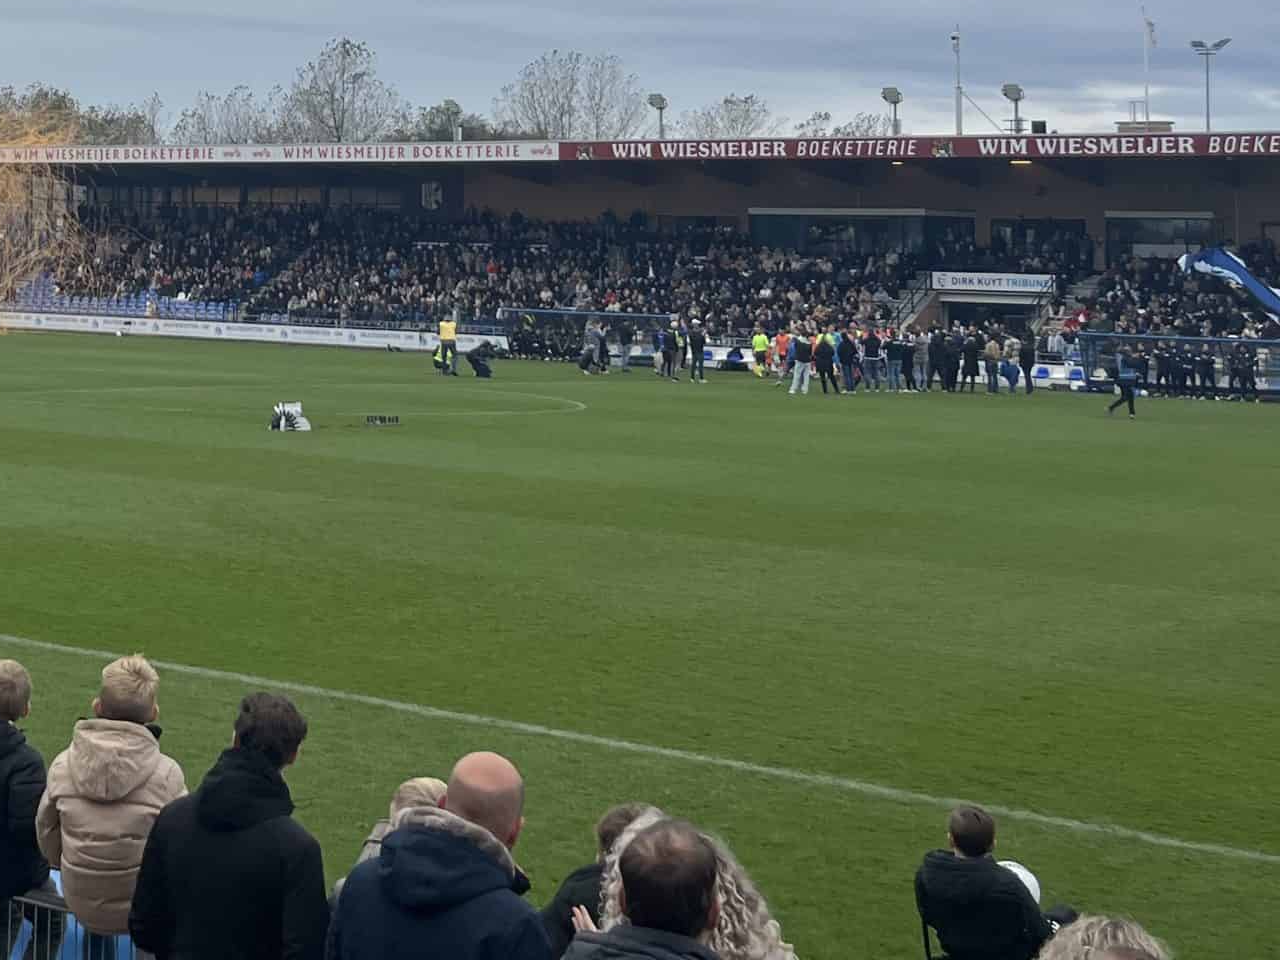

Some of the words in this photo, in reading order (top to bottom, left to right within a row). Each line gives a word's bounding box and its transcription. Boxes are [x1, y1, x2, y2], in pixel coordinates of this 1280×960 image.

[283, 147, 313, 159] WIM
[318, 146, 406, 160] WIESMEIJER
[412, 144, 520, 159] BOEKETTERIE
[612, 143, 652, 158] WIM
[660, 141, 787, 157] WIESMEIJER
[797, 139, 917, 156] BOEKETTERIE
[978, 138, 1028, 154] WIM
[1036, 137, 1195, 154] WIESMEIJER
[1208, 135, 1280, 153] BOEKE
[14, 148, 39, 160] WIM
[46, 148, 120, 161] WIESMEIJER
[123, 146, 215, 160] BOEKETTERIE
[951, 276, 975, 287] DIRK
[976, 277, 1003, 288] KUYT
